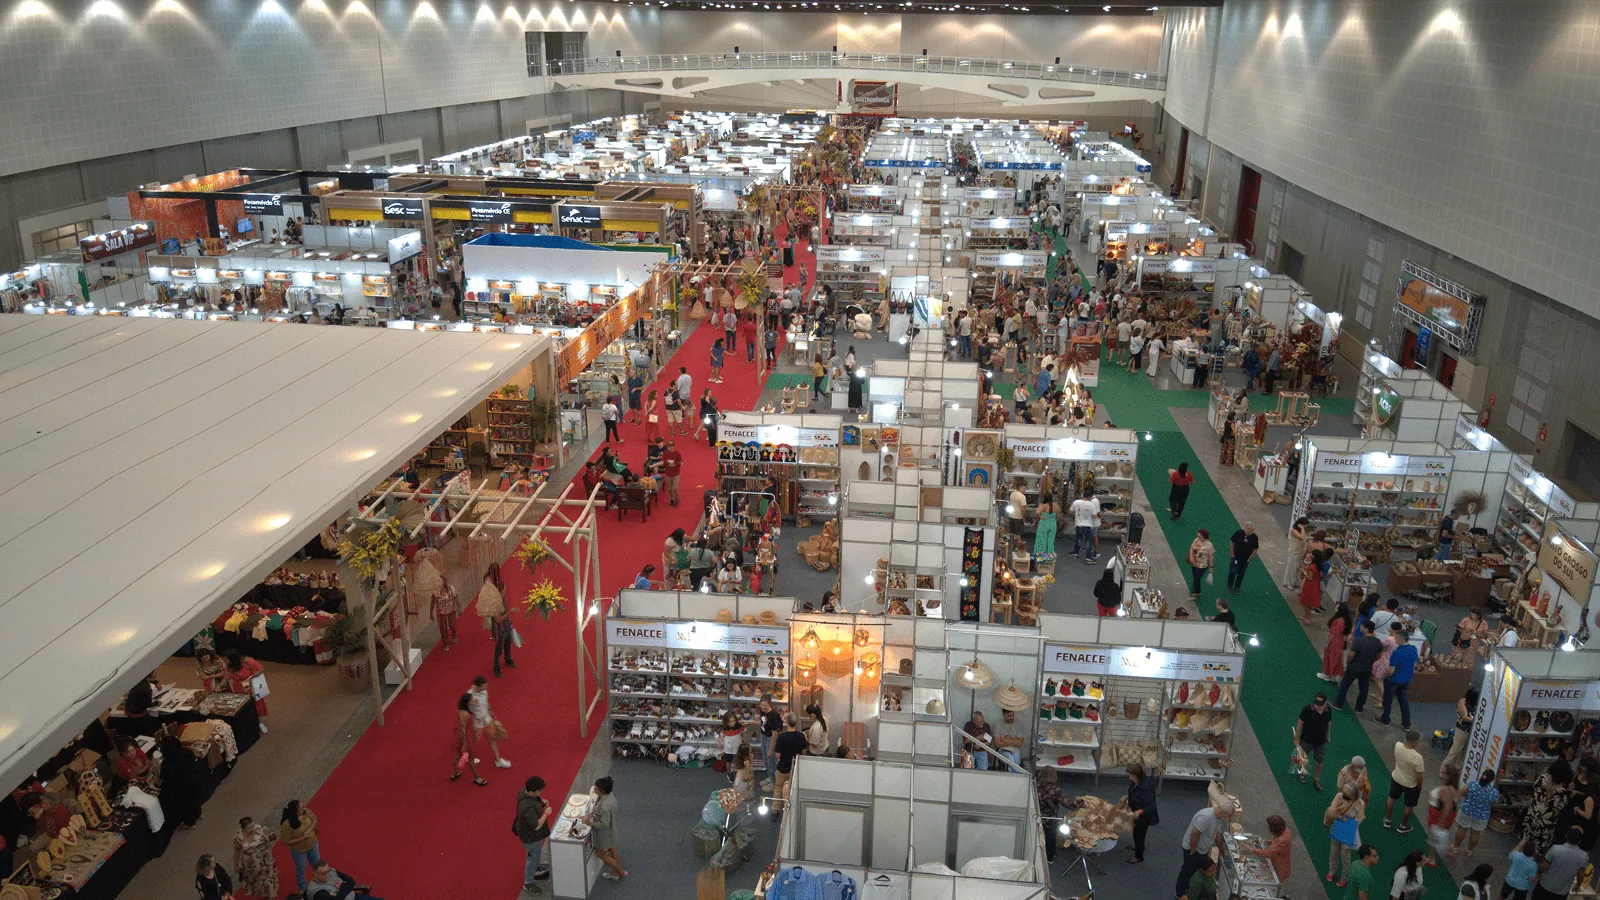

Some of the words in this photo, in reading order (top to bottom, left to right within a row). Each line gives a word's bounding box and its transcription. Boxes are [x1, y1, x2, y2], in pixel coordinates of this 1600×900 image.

[384, 205, 405, 215] Sesc
[560, 215, 583, 223] Senac
[104, 236, 124, 252] SALA
[123, 233, 135, 246] VIP
[724, 430, 755, 438] FENACCE
[1012, 444, 1046, 453] FENACCE
[1323, 458, 1359, 466] FENACCE
[1552, 556, 1563, 570] DO
[1562, 564, 1574, 582] SUL
[1562, 551, 1588, 580] GROSSO
[616, 627, 662, 639] FENACCE
[1056, 651, 1105, 664] FENACCE
[1531, 688, 1581, 699] FENACCE
[1462, 749, 1475, 784] MATO
[1471, 697, 1487, 748] GROSSO
[1473, 752, 1481, 771] DO
[1478, 728, 1488, 751] SUL
